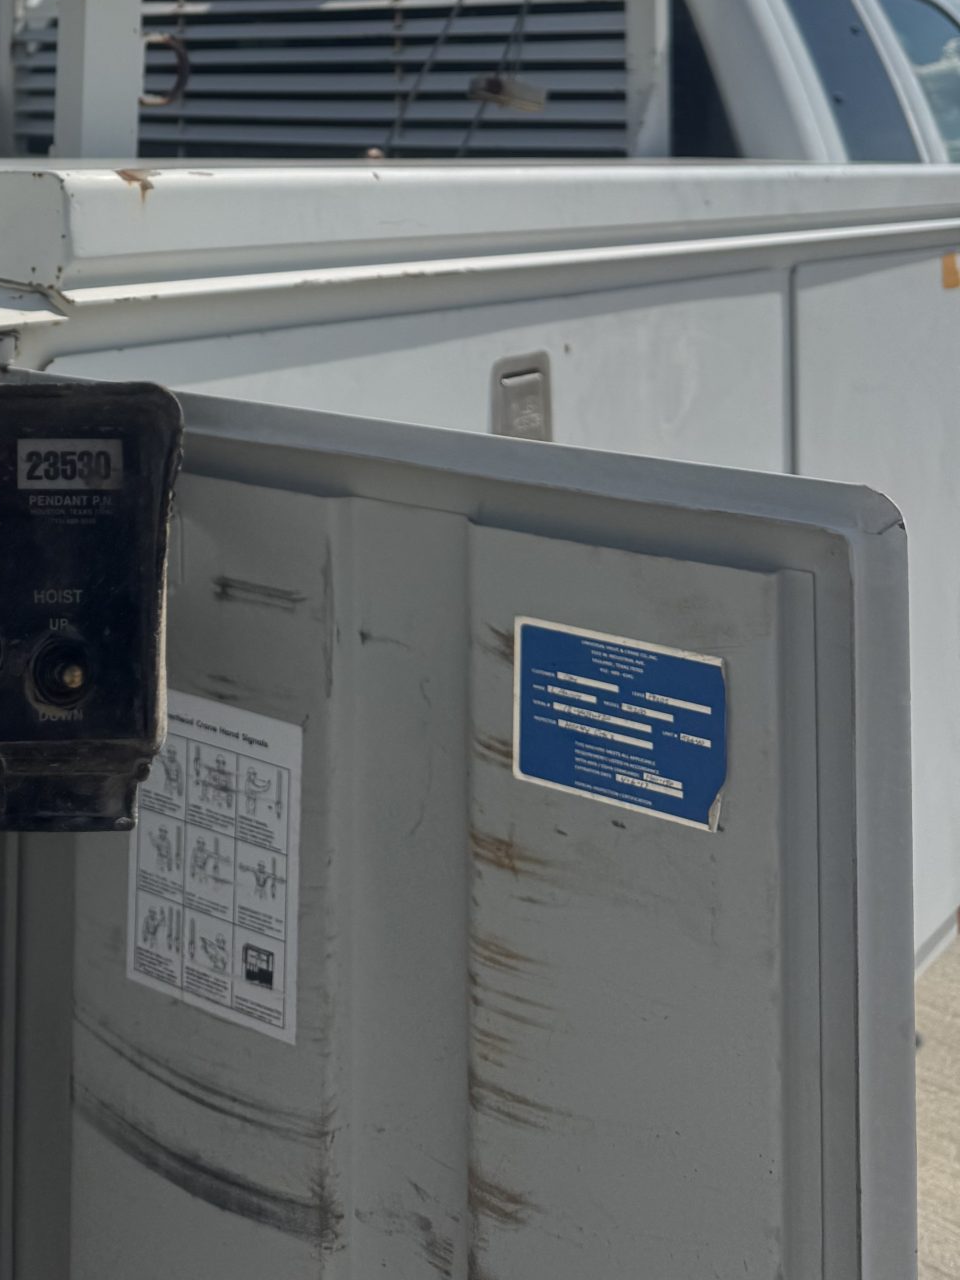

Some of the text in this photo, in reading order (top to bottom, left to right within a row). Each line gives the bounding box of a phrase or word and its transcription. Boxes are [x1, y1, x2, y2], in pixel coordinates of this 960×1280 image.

[26, 450, 111, 481] 23530
[29, 495, 88, 506] PENDANT
[33, 589, 84, 605] HOIST
[49, 618, 69, 631] UP
[38, 709, 84, 722] DOWN
[196, 719, 218, 733] Crane
[219, 726, 240, 740] Hand
